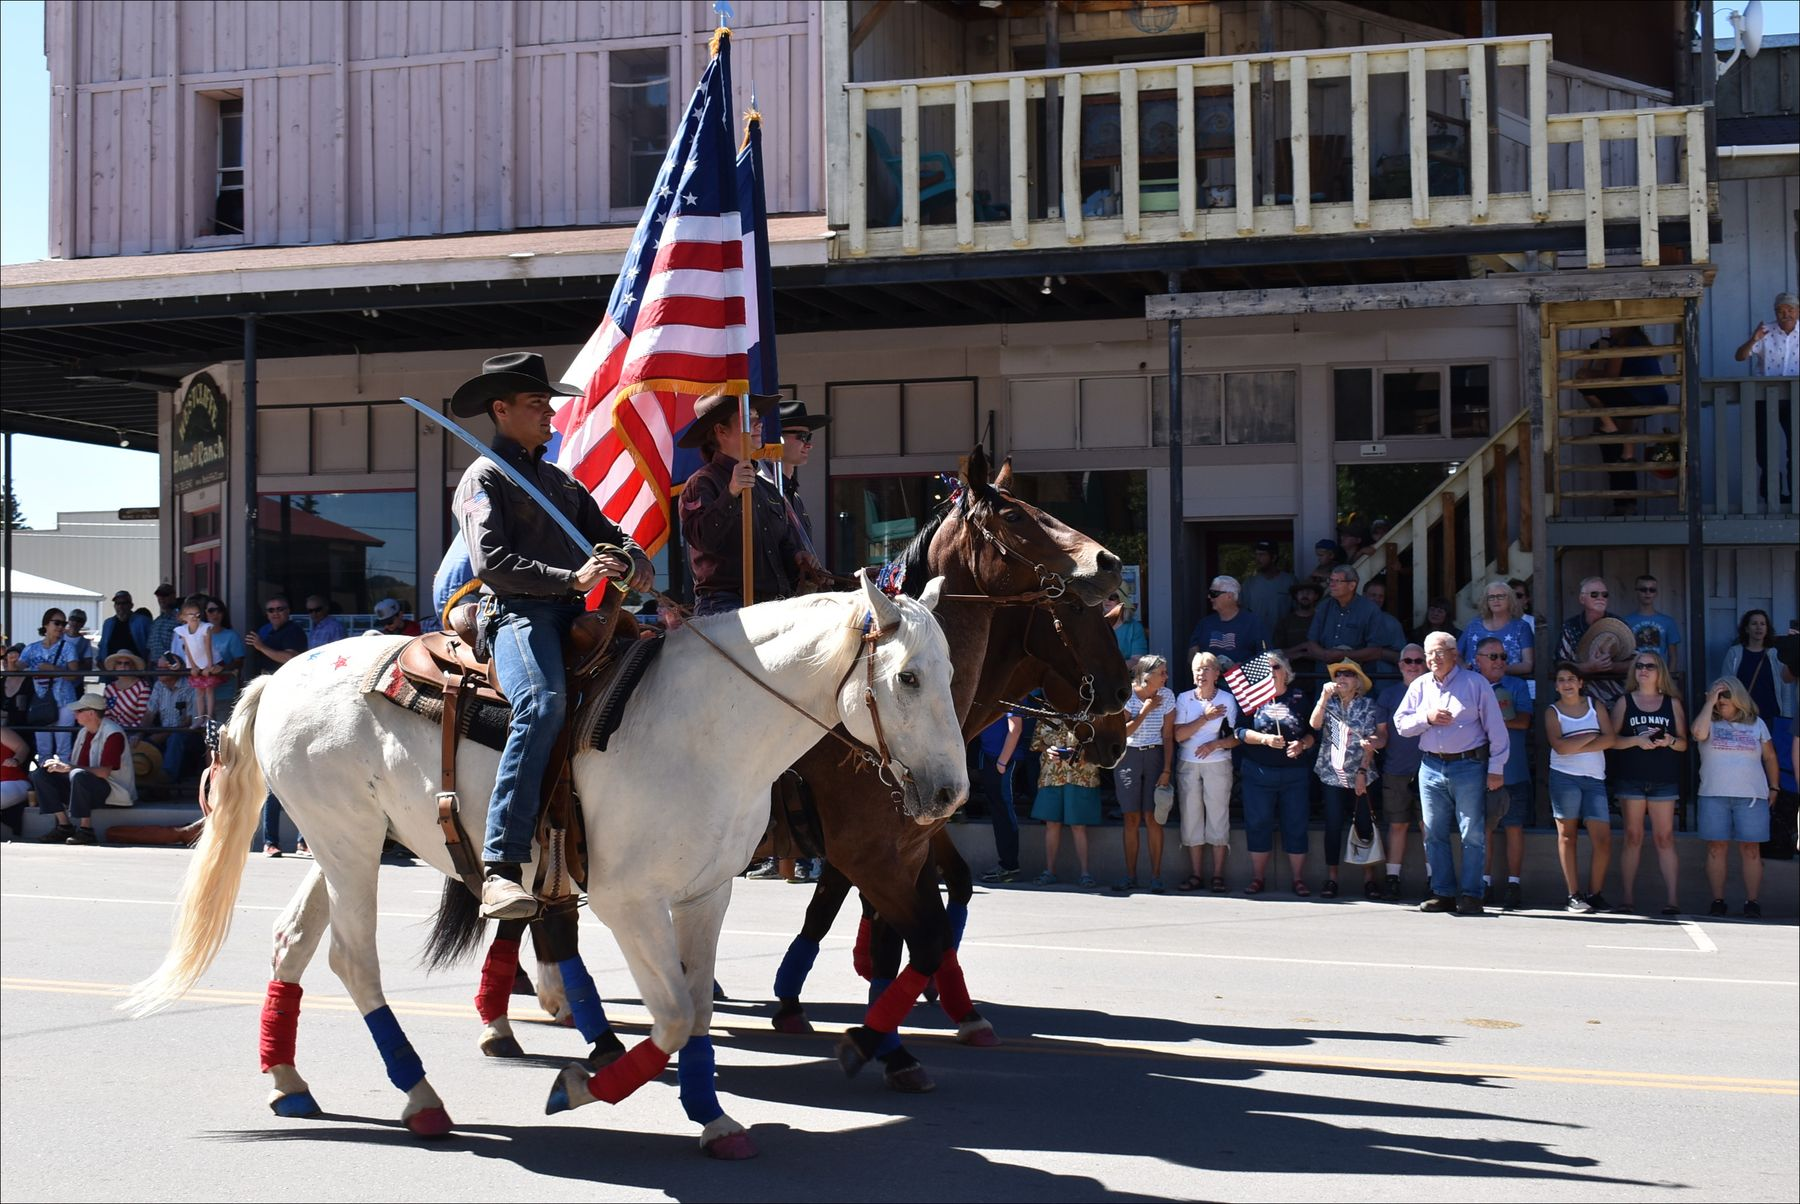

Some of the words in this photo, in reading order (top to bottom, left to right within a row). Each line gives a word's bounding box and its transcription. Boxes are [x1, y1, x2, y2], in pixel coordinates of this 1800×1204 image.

[198, 435, 225, 466] Ranch
[1630, 716, 1647, 726] OLD
[1648, 716, 1669, 727] NAVY
